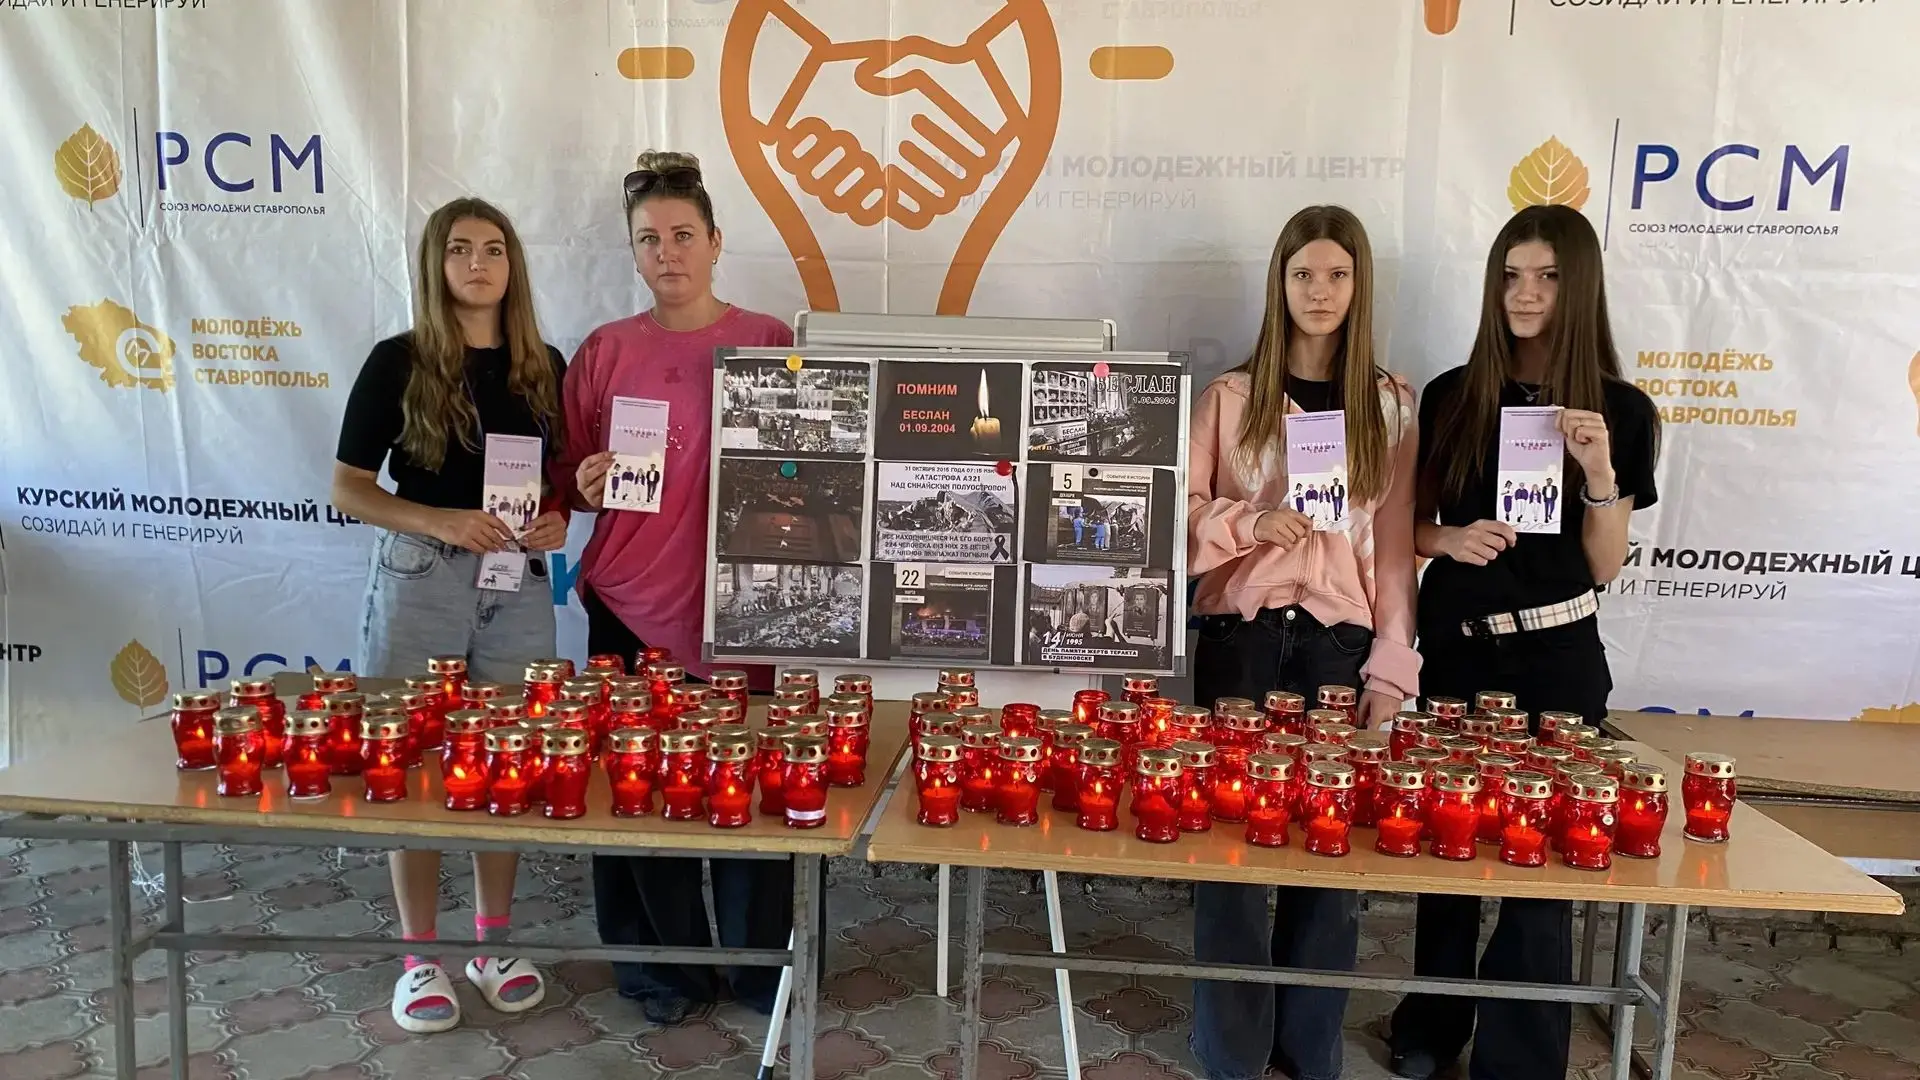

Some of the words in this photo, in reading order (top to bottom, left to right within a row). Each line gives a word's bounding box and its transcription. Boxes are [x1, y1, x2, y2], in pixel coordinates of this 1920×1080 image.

[155, 131, 325, 194] РСМ
[1063, 152, 1296, 182] МОЛОДЕЖНЫЙ
[1305, 156, 1407, 182] ЦЕНТР
[1631, 144, 1850, 212] РСМ
[159, 202, 189, 212] СОЮЗ
[191, 203, 251, 214] МОЛОДЕЖИ
[253, 205, 326, 215] СТАВРОПОЛЬЯ
[1058, 187, 1197, 210] ГЕНЕРИРУЙ
[1628, 223, 1666, 235] СОЮЗ
[1668, 224, 1744, 236] МОЛОДЕЖИ
[1747, 224, 1840, 237] СТАВРОПОЛЬЯ
[191, 315, 303, 338] МОЛОДЁЖЬ
[191, 343, 279, 363] ВОСТОКА
[1637, 349, 1774, 373] МОЛОДЁЖЬ
[194, 367, 330, 389] СТАВРОПОЛЬЯ
[1096, 374, 1177, 394] БЕСЛАН
[1634, 377, 1739, 399] ВОСТОКА
[897, 383, 958, 396] ПОМНИМ
[903, 410, 950, 421] БЕСЛАН
[1659, 405, 1798, 428] АВРОПОЛЬЯ
[899, 423, 956, 434] 01.09.2004
[890, 482, 906, 490] НАД
[1063, 473, 1073, 490] 5
[16, 486, 126, 511] КУРСКИЙ
[131, 494, 320, 523] МОЛОДЕЖНЫЙ
[21, 515, 106, 538] СОЗИДАЙ
[112, 521, 127, 535] И
[132, 522, 244, 545] ГЕНЕРИРУЙ
[1651, 547, 1894, 576] МОЛОДЕЖНЫЙ
[901, 569, 920, 587] 22
[1620, 578, 1636, 596] И
[1644, 579, 1788, 601] ГЕНЕРИРУЙ
[1043, 631, 1061, 648] 14
[0, 642, 42, 662] НТР
